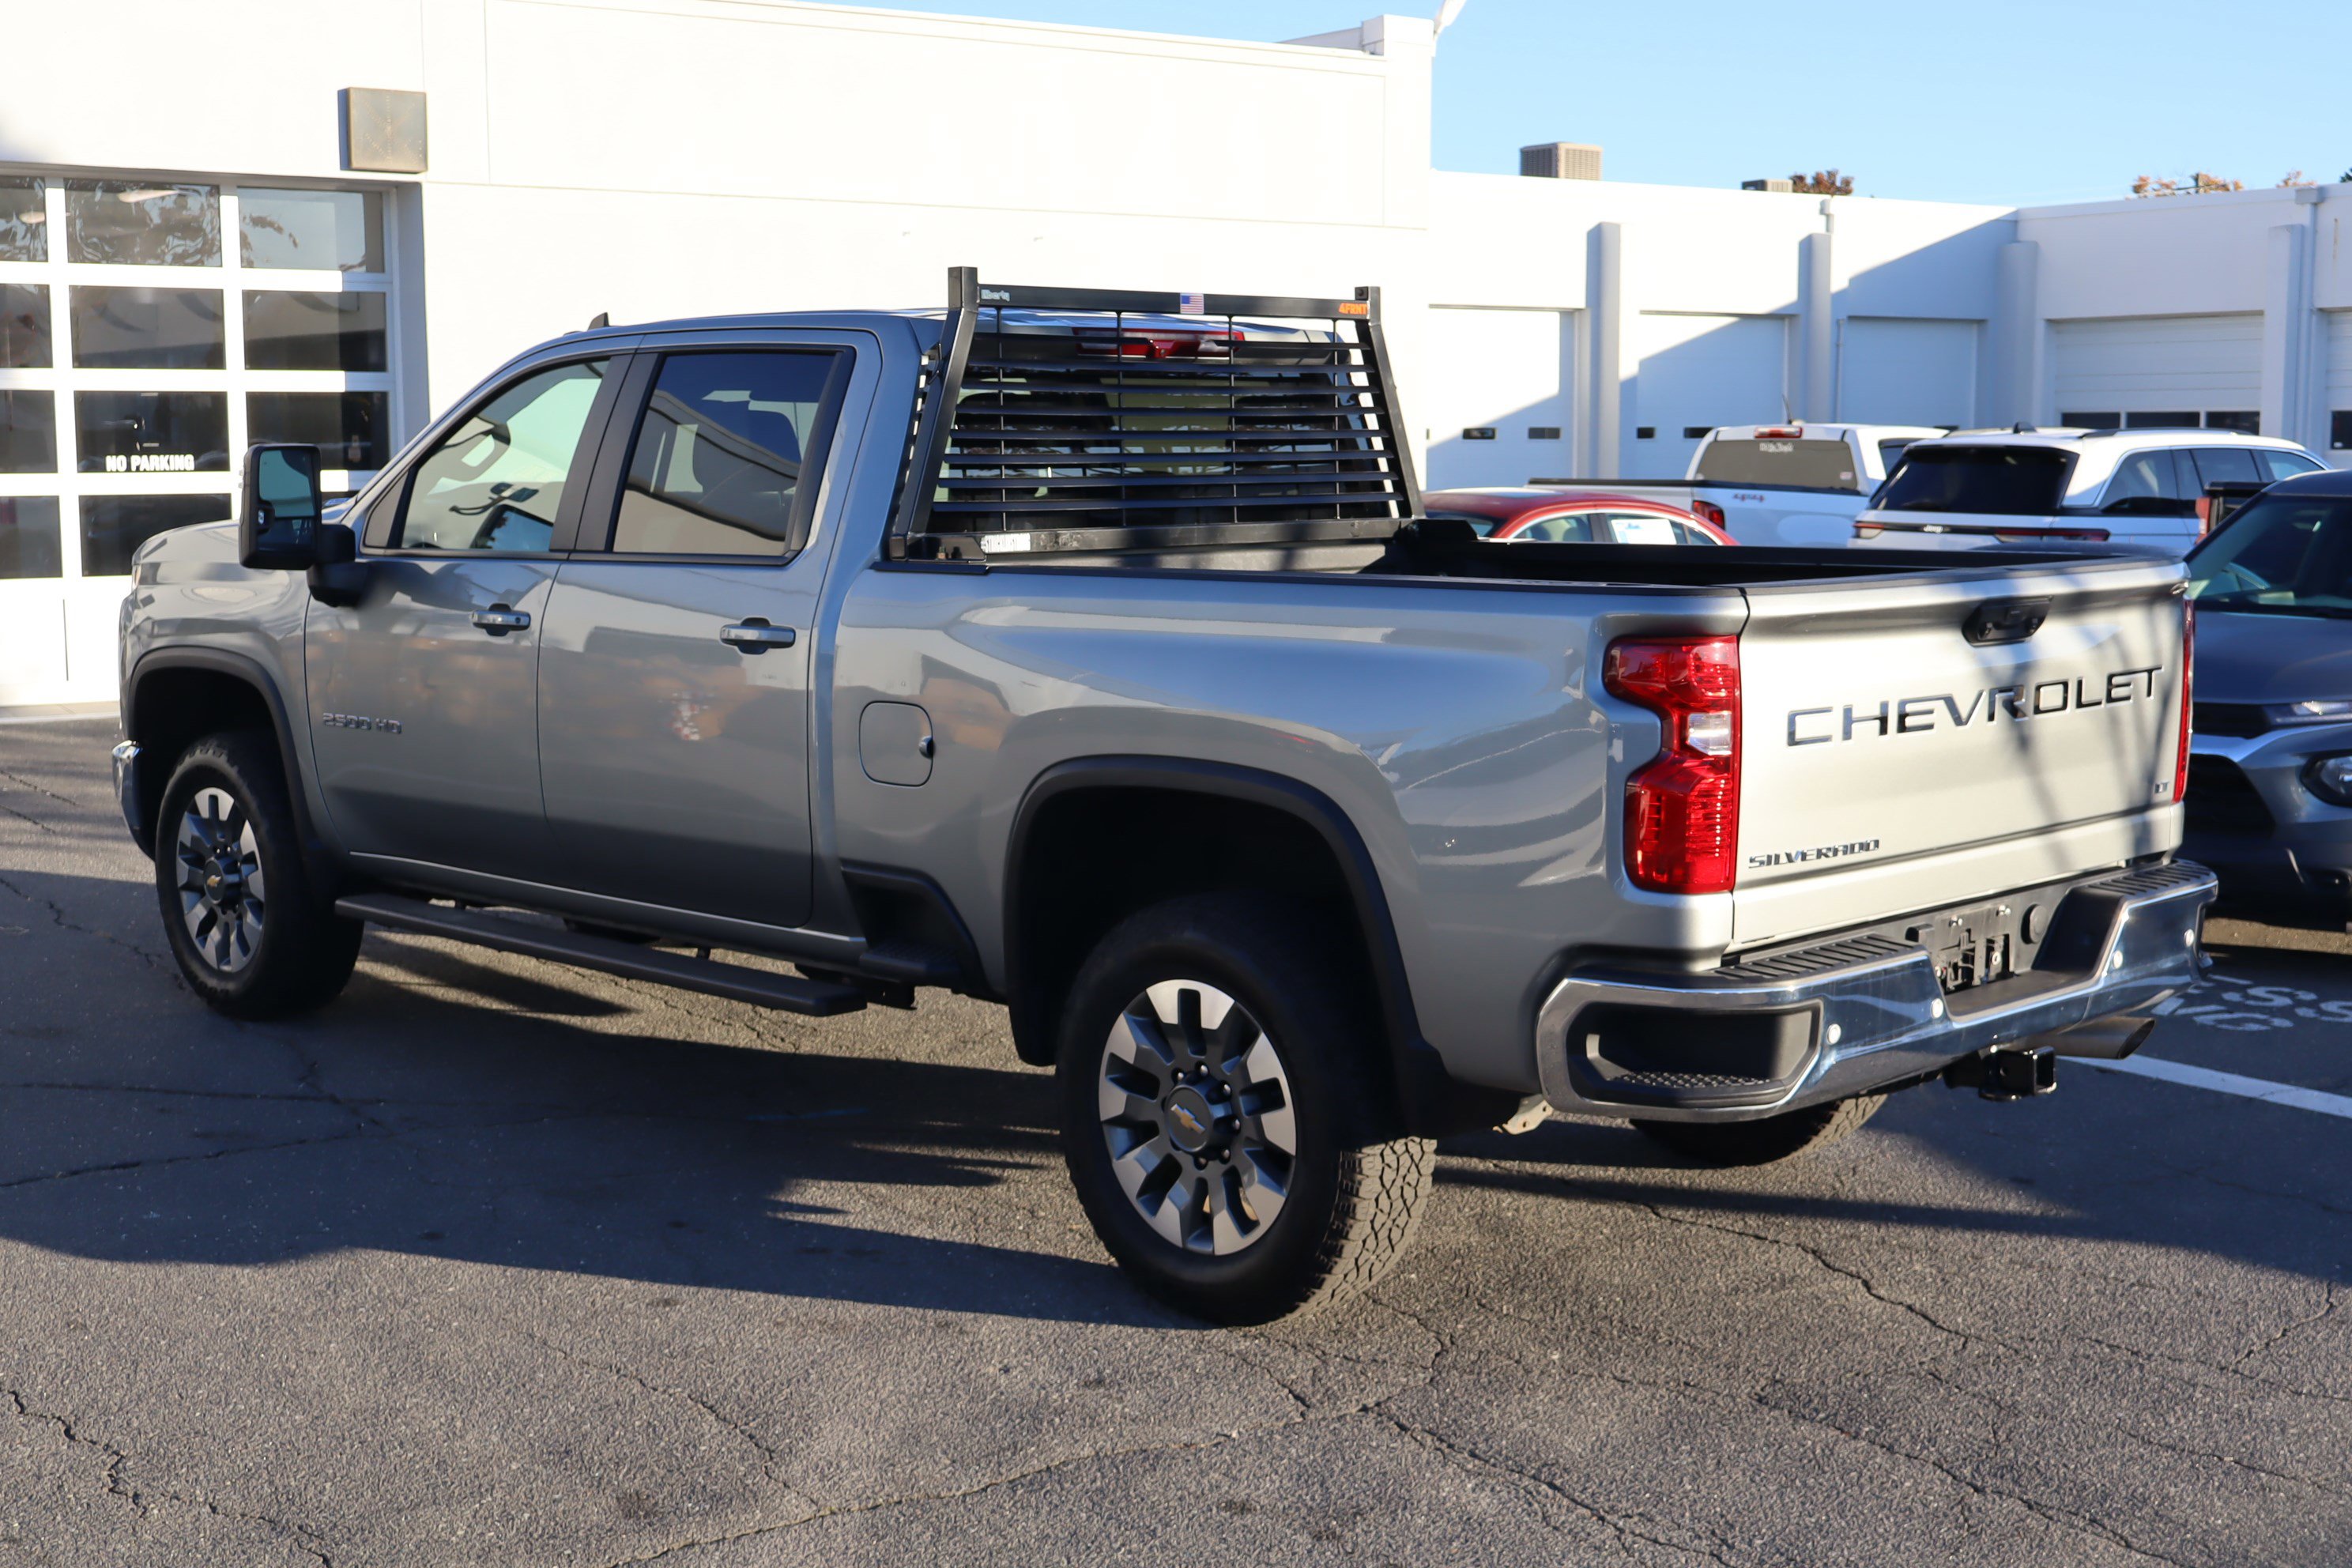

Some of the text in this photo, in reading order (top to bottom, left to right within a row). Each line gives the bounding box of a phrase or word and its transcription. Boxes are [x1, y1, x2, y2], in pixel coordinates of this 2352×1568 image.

[105, 454, 195, 472] NO PARKING
[1787, 665, 2163, 747] CHEVROLET
[322, 712, 402, 734] 2500 HD
[2154, 780, 2170, 794] LT
[1748, 839, 1879, 869] SILVERADO
